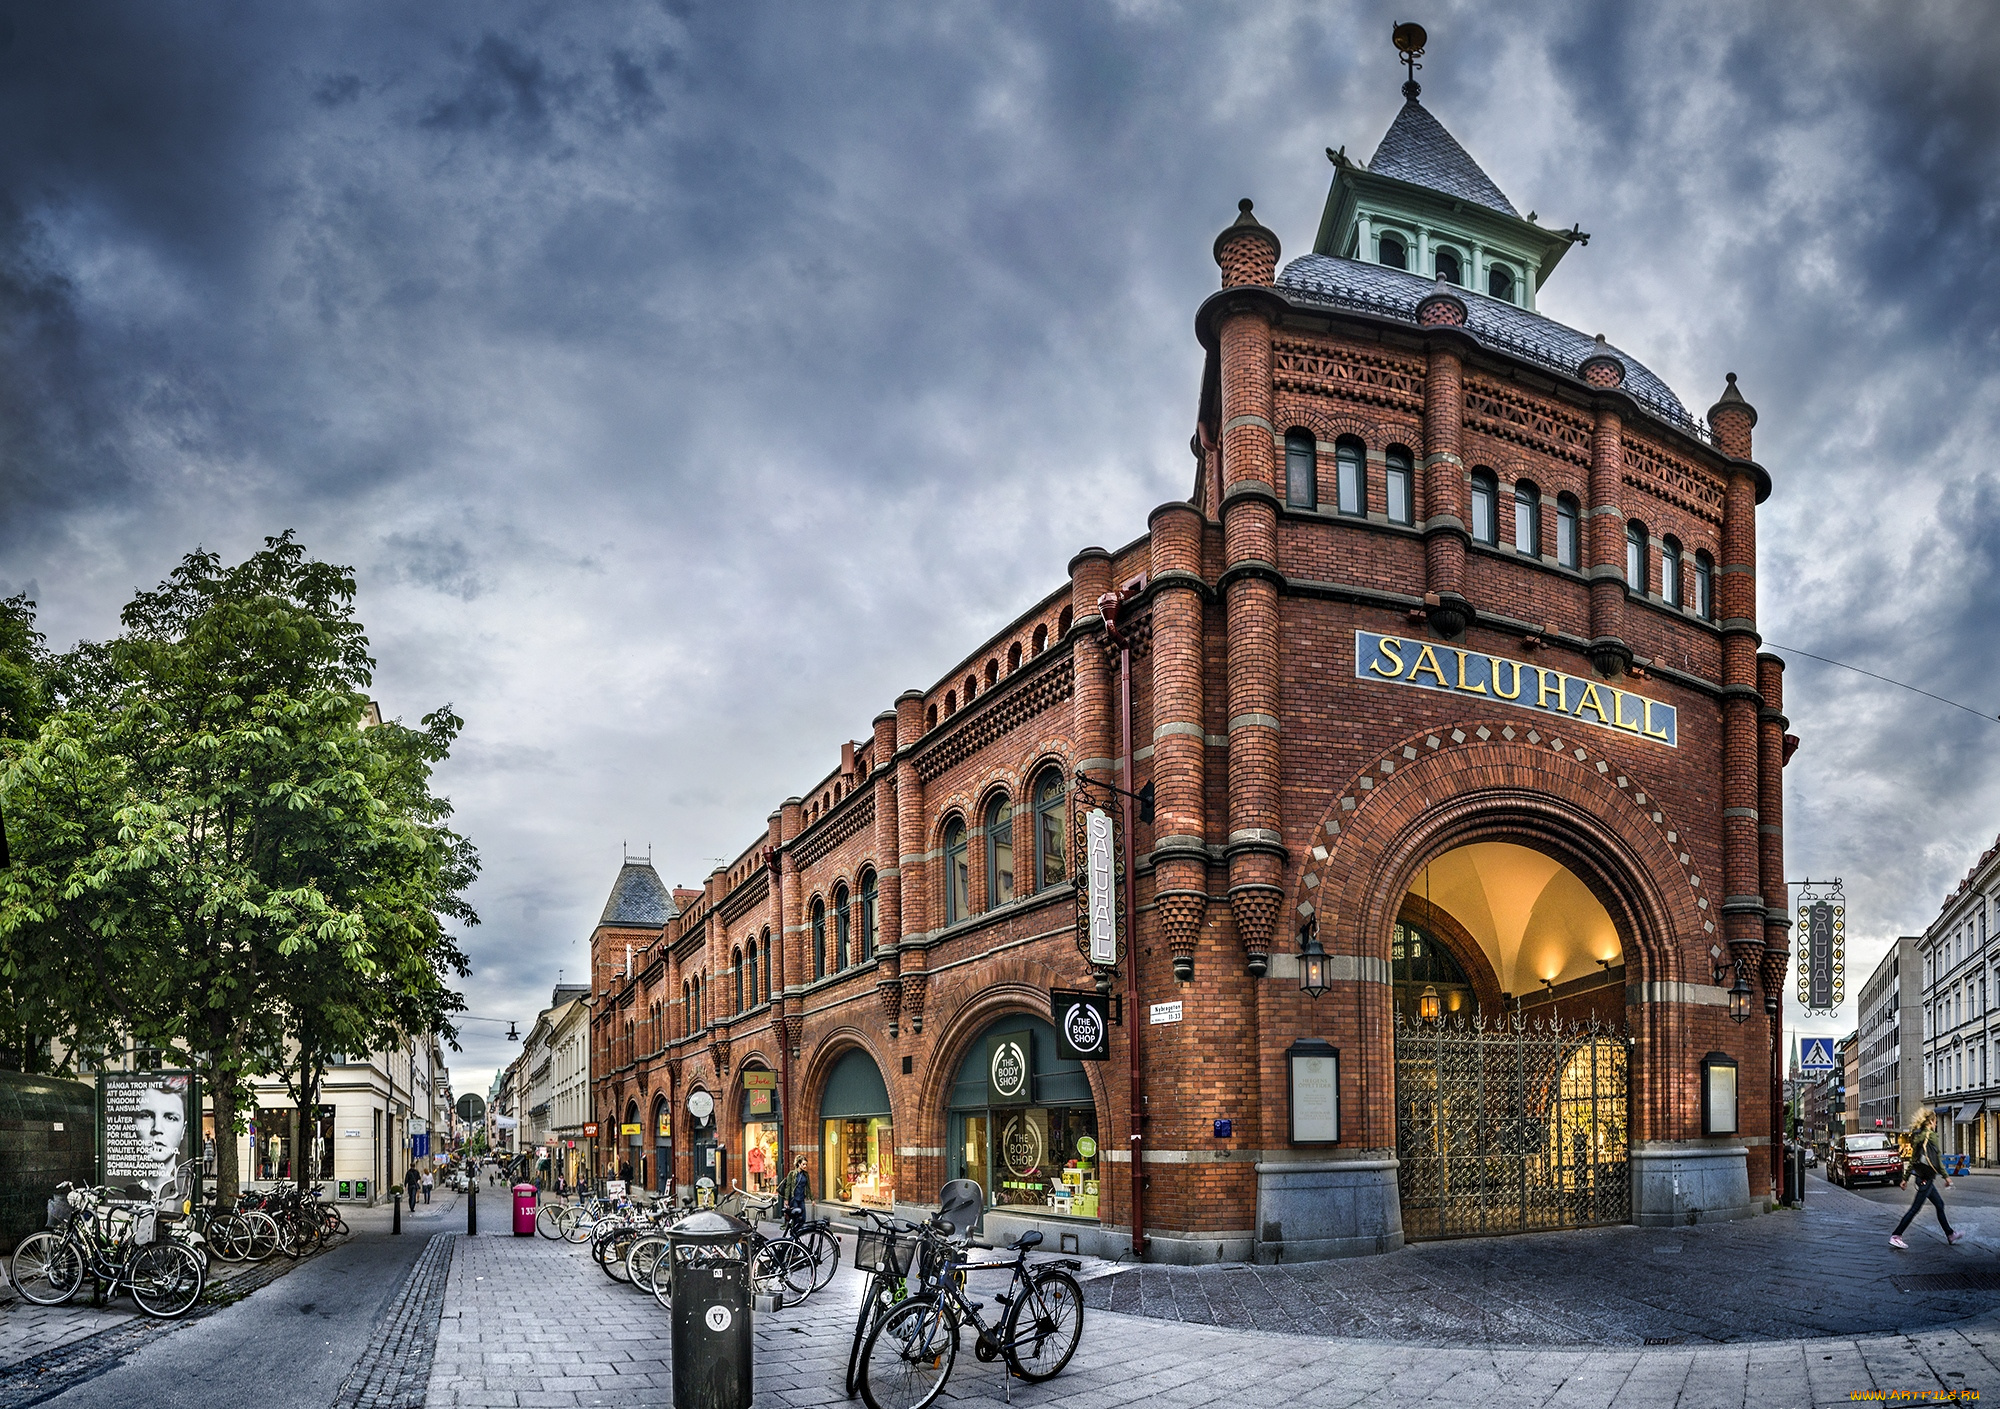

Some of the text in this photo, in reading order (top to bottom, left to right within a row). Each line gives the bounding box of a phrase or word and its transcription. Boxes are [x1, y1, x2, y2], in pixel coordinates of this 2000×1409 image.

[1369, 637, 1668, 741] SALUHALL
[1092, 817, 1111, 958] SALUHALL
[1813, 907, 1829, 1005] SALUHALL
[1077, 1018, 1091, 1026] THE
[1073, 1025, 1096, 1035] BODY
[1074, 1034, 1096, 1043] SHOP
[1002, 1058, 1014, 1067] THE
[998, 1066, 1020, 1077] BODY
[107, 1081, 129, 1089] MÅNGA
[999, 1077, 1018, 1086] SHOP
[114, 1115, 133, 1123] LÅTER
[107, 1131, 137, 1139] FÖR HELA
[1014, 1133, 1029, 1143] THE
[1010, 1144, 1034, 1154] BODY
[1011, 1155, 1034, 1165] SHOP
[107, 1169, 131, 1177] GÄSTER
[132, 1169, 147, 1177] OCH
